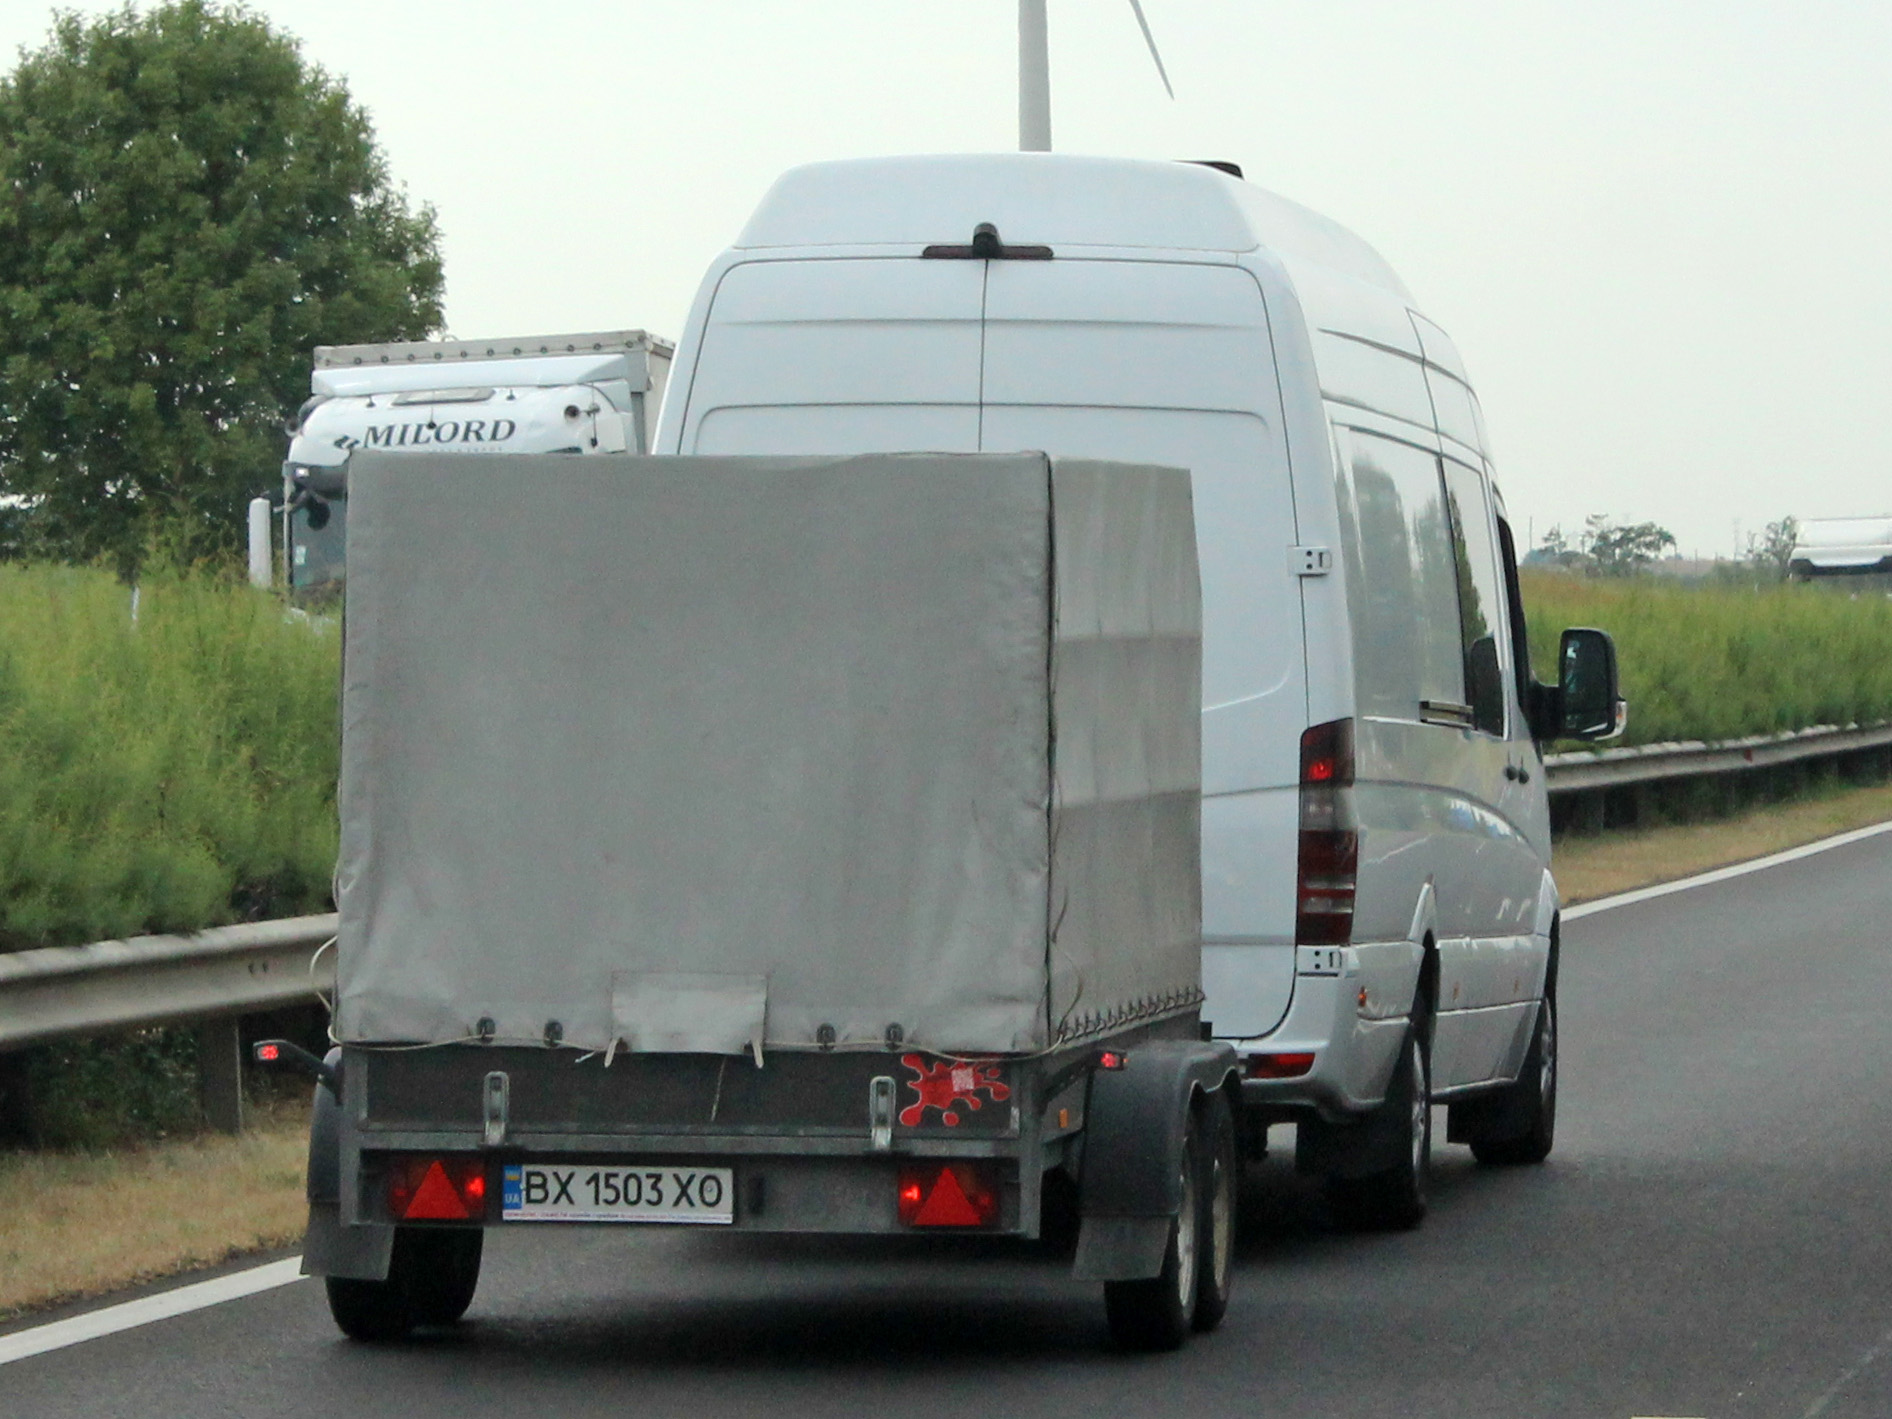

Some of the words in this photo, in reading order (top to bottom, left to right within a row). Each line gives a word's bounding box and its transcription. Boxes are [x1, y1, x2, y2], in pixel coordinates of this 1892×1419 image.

[364, 419, 516, 448] MILORD
[504, 1193, 520, 1204] UA
[525, 1171, 575, 1205] BX
[585, 1172, 663, 1206] 1503
[672, 1173, 723, 1207] XO
